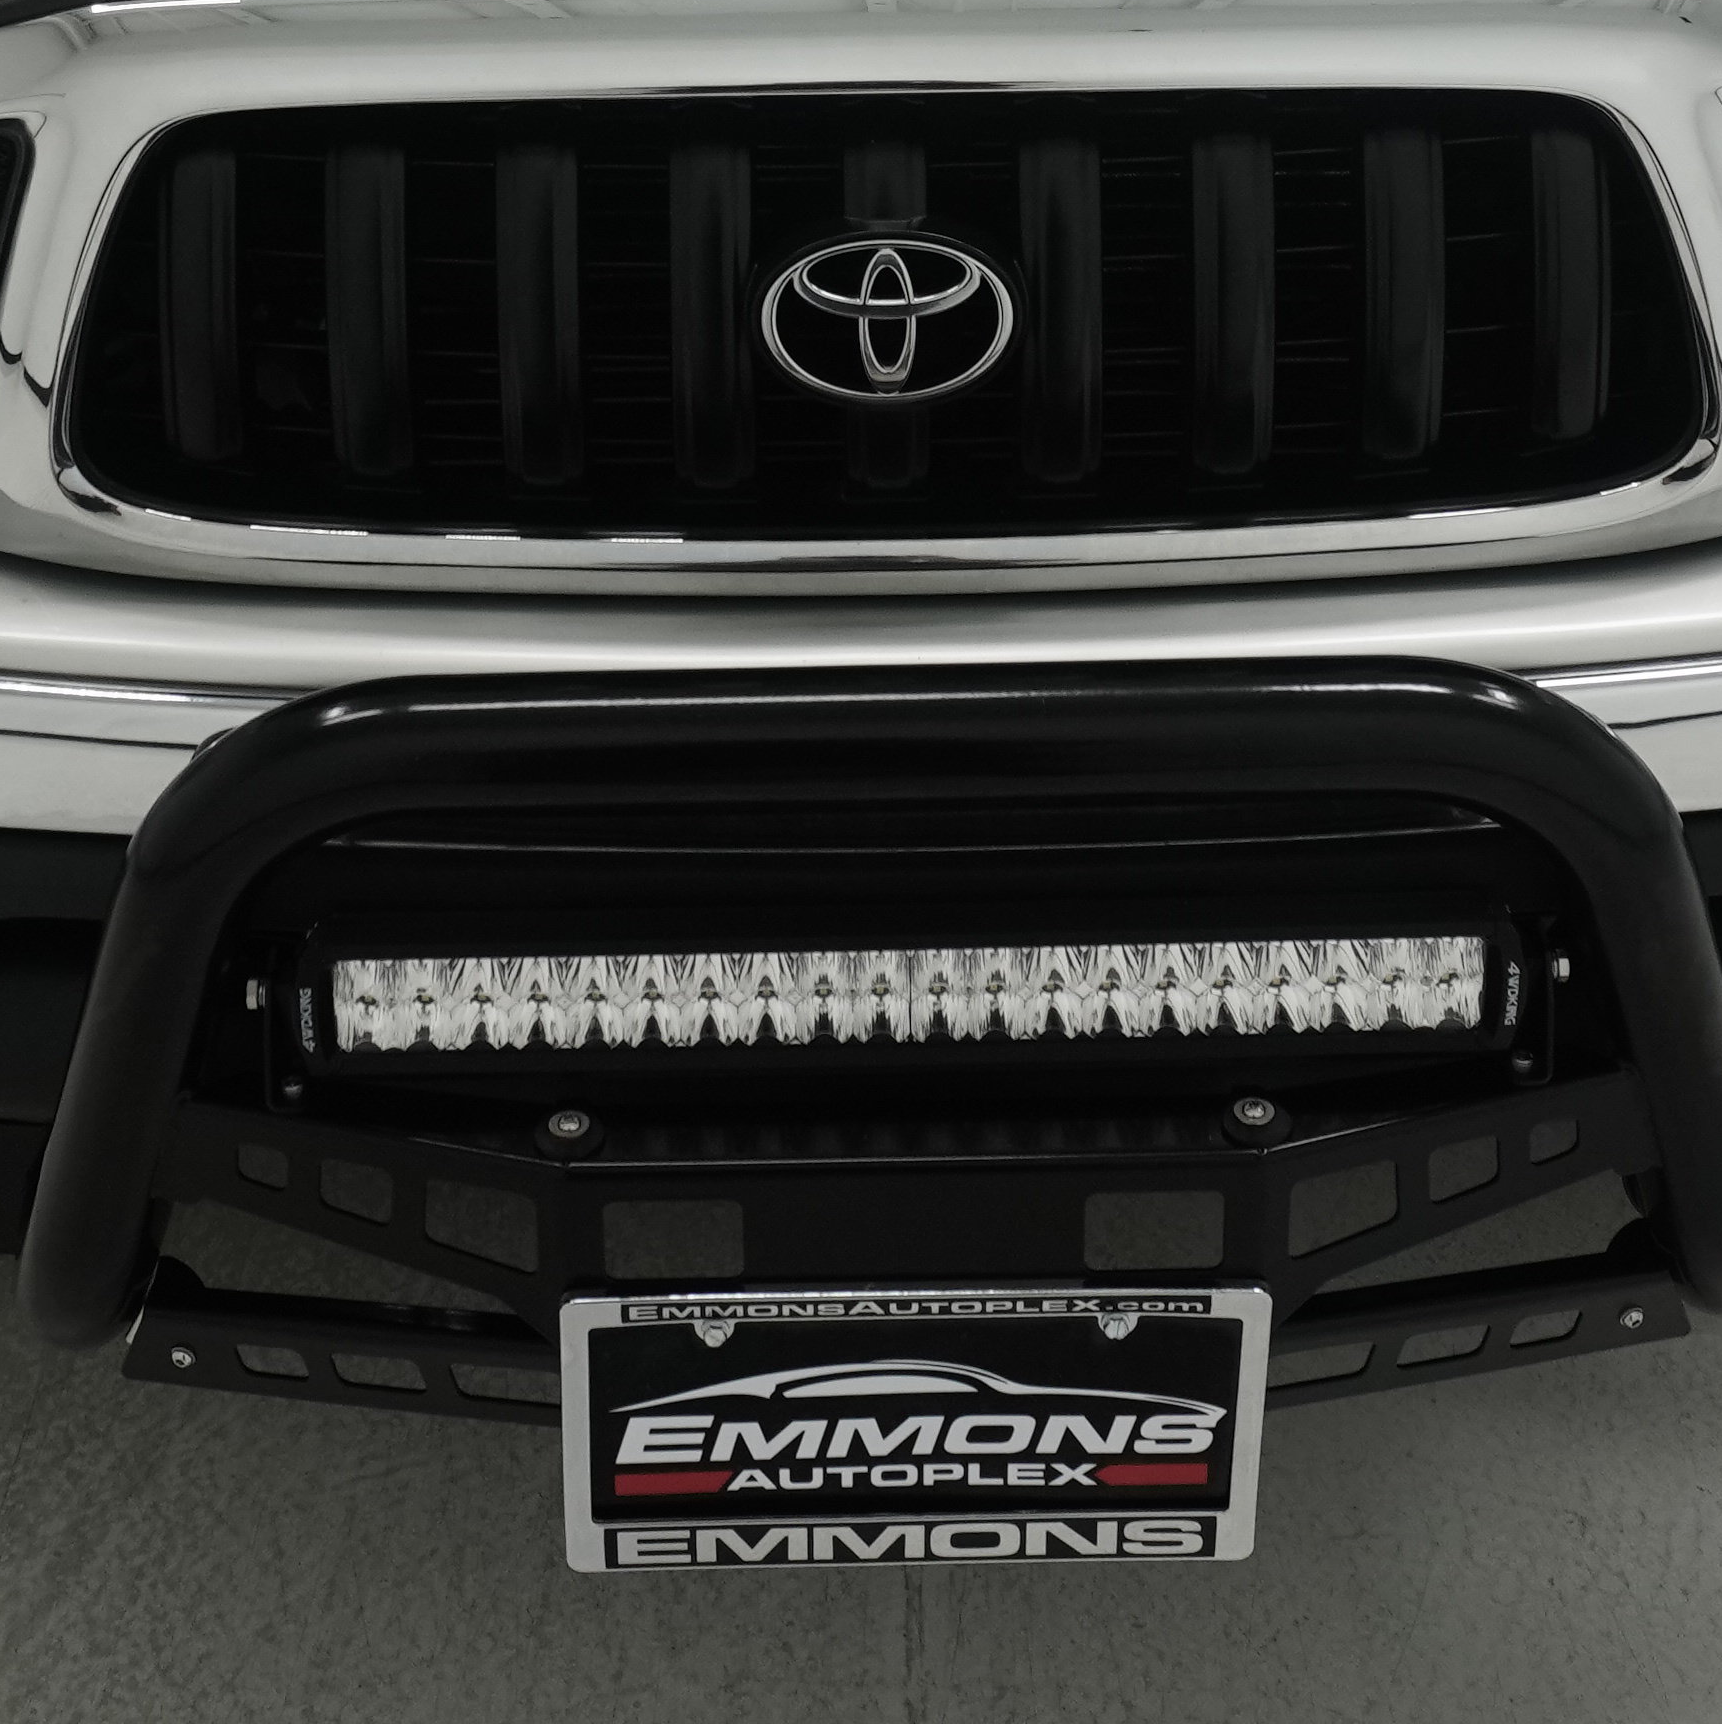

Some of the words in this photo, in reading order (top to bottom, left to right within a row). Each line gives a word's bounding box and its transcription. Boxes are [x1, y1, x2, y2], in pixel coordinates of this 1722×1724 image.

[1504, 961, 1521, 1026] 4WDKING
[299, 987, 316, 1053] 4WDKING
[615, 1414, 1217, 1465] EMMONS
[725, 1463, 1098, 1491] AUTOPLEX
[616, 1519, 1205, 1565] EMMONS
